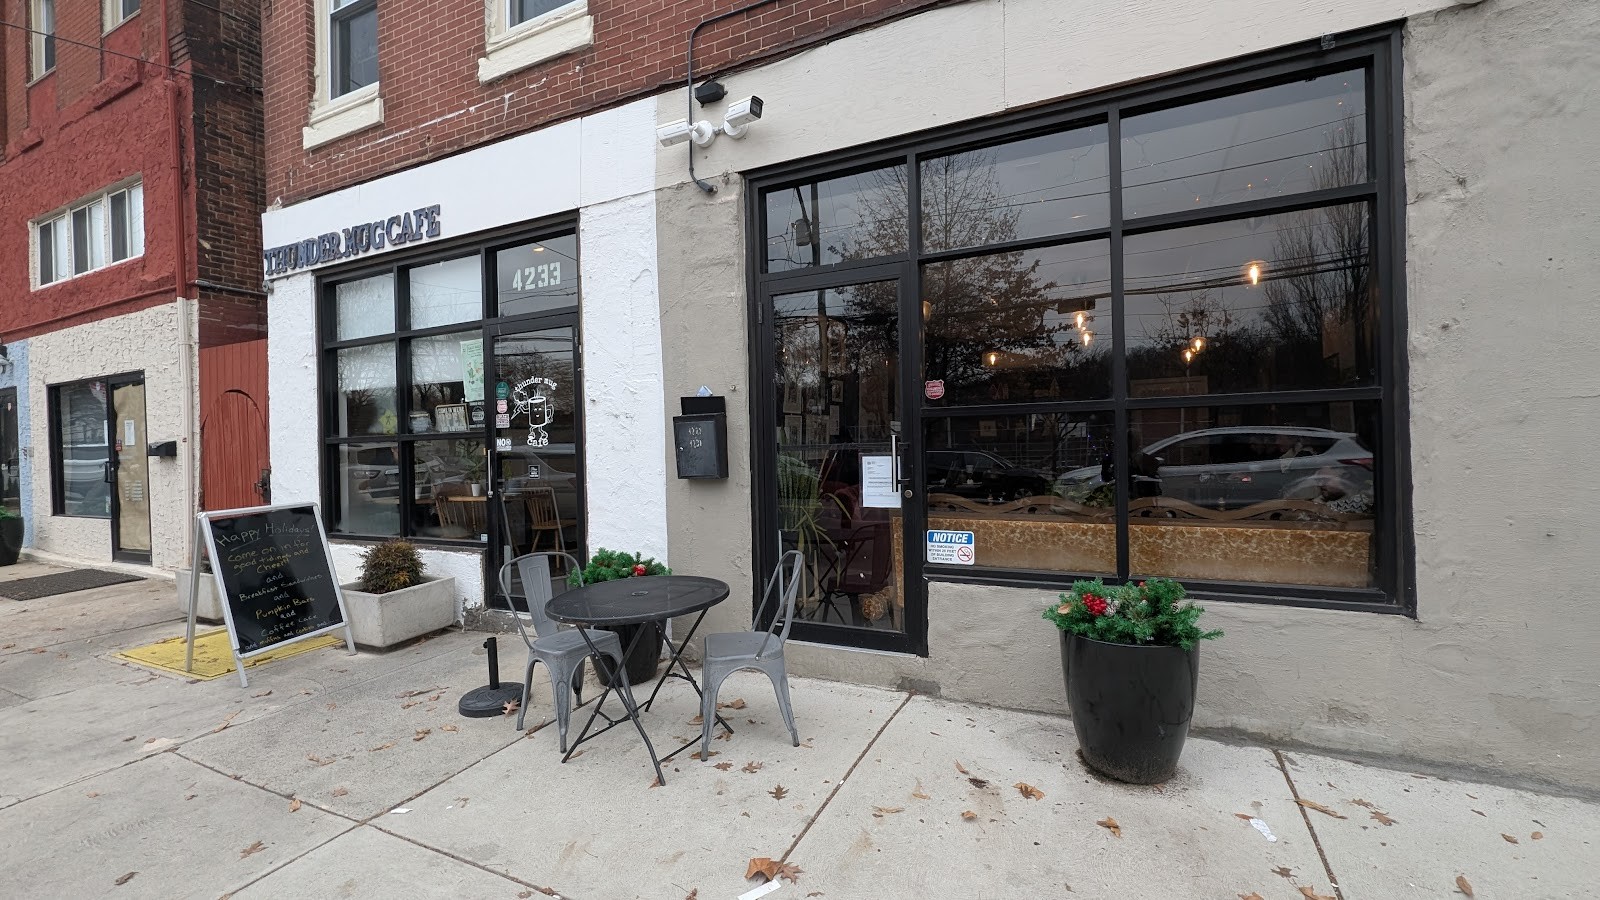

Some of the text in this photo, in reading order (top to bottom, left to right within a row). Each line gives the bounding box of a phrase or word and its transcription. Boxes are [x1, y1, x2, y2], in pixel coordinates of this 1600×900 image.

[263, 204, 441, 276] THUNDER MUG CAFE
[512, 262, 562, 291] 4233
[514, 376, 542, 391] thunder
[544, 378, 558, 390] mug
[216, 528, 260, 546] Happy
[262, 545, 276, 554] on
[281, 542, 291, 550] in
[294, 536, 310, 548] for
[932, 532, 968, 543] NOTICE
[234, 560, 256, 576] good
[294, 548, 310, 556] and
[266, 572, 284, 584] and
[239, 586, 278, 602] Breakfast
[274, 591, 290, 601] and
[256, 604, 290, 620] Pumpkin
[280, 609, 296, 619] and
[260, 620, 294, 637] Coffee
